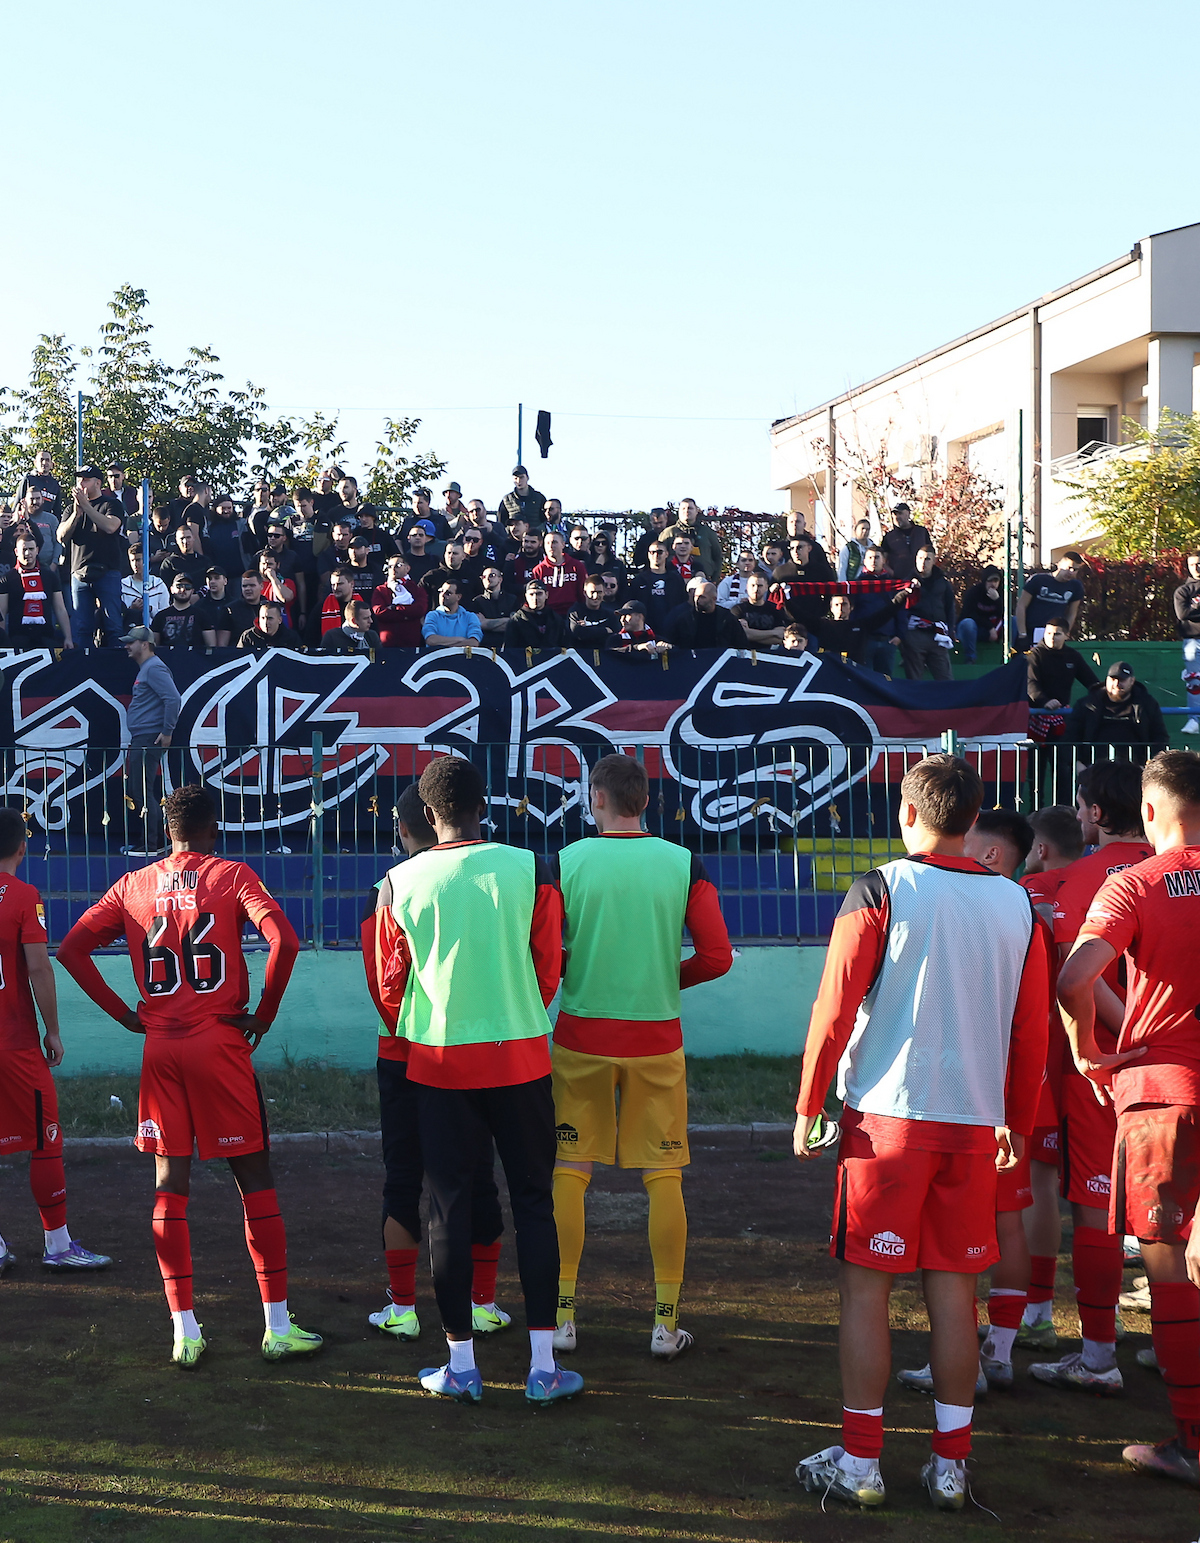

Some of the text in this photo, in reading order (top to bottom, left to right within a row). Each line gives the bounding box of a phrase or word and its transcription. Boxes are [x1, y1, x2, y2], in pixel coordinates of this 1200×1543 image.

[155, 870, 199, 894] JARJU
[155, 892, 197, 912] mts
[141, 912, 226, 997] 66
[872, 1239, 905, 1255] KMC
[558, 1297, 573, 1308] FS
[658, 1303, 673, 1316] FS
